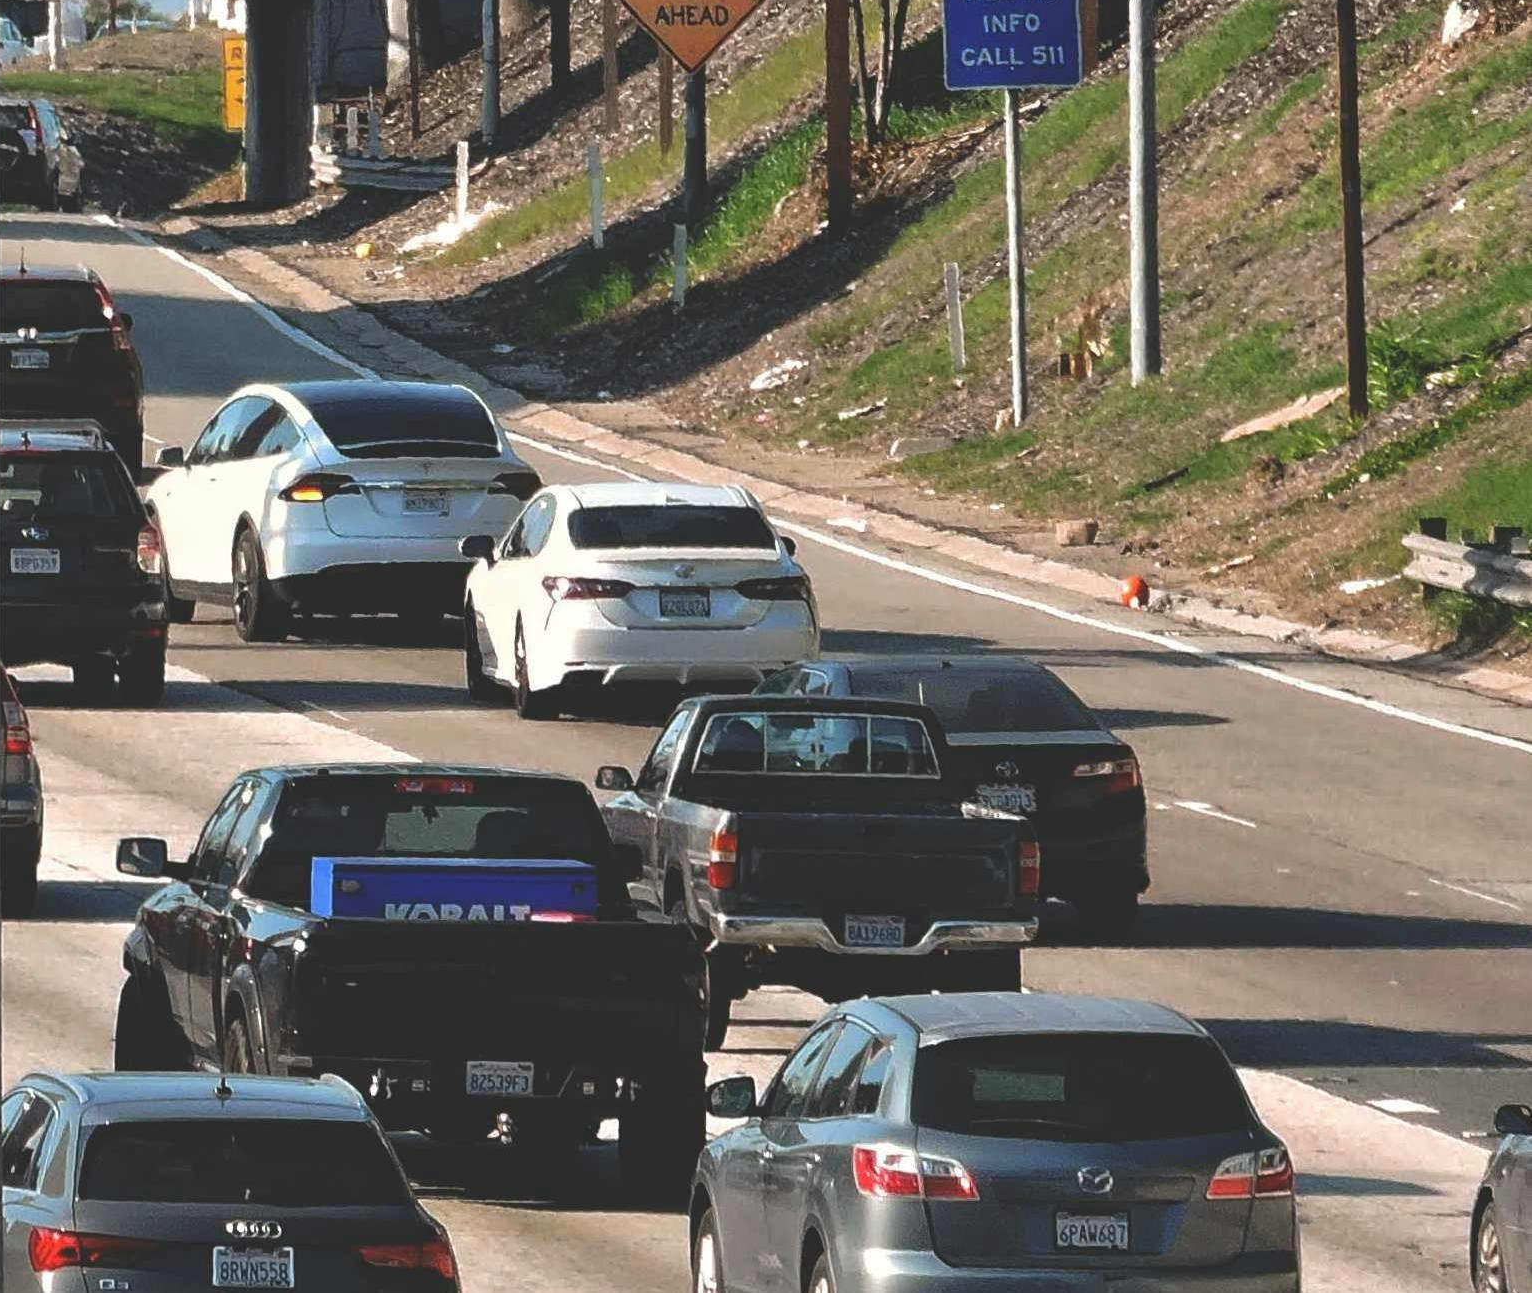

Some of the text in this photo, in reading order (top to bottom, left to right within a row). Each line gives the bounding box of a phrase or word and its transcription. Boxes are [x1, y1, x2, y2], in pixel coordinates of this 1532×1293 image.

[655, 5, 730, 27] AHEAD
[983, 13, 1041, 33] INFO
[960, 45, 1065, 67] CALL 511
[1058, 1222, 1127, 1245] 6PAW687
[219, 1260, 291, 1282] 8RWN558
